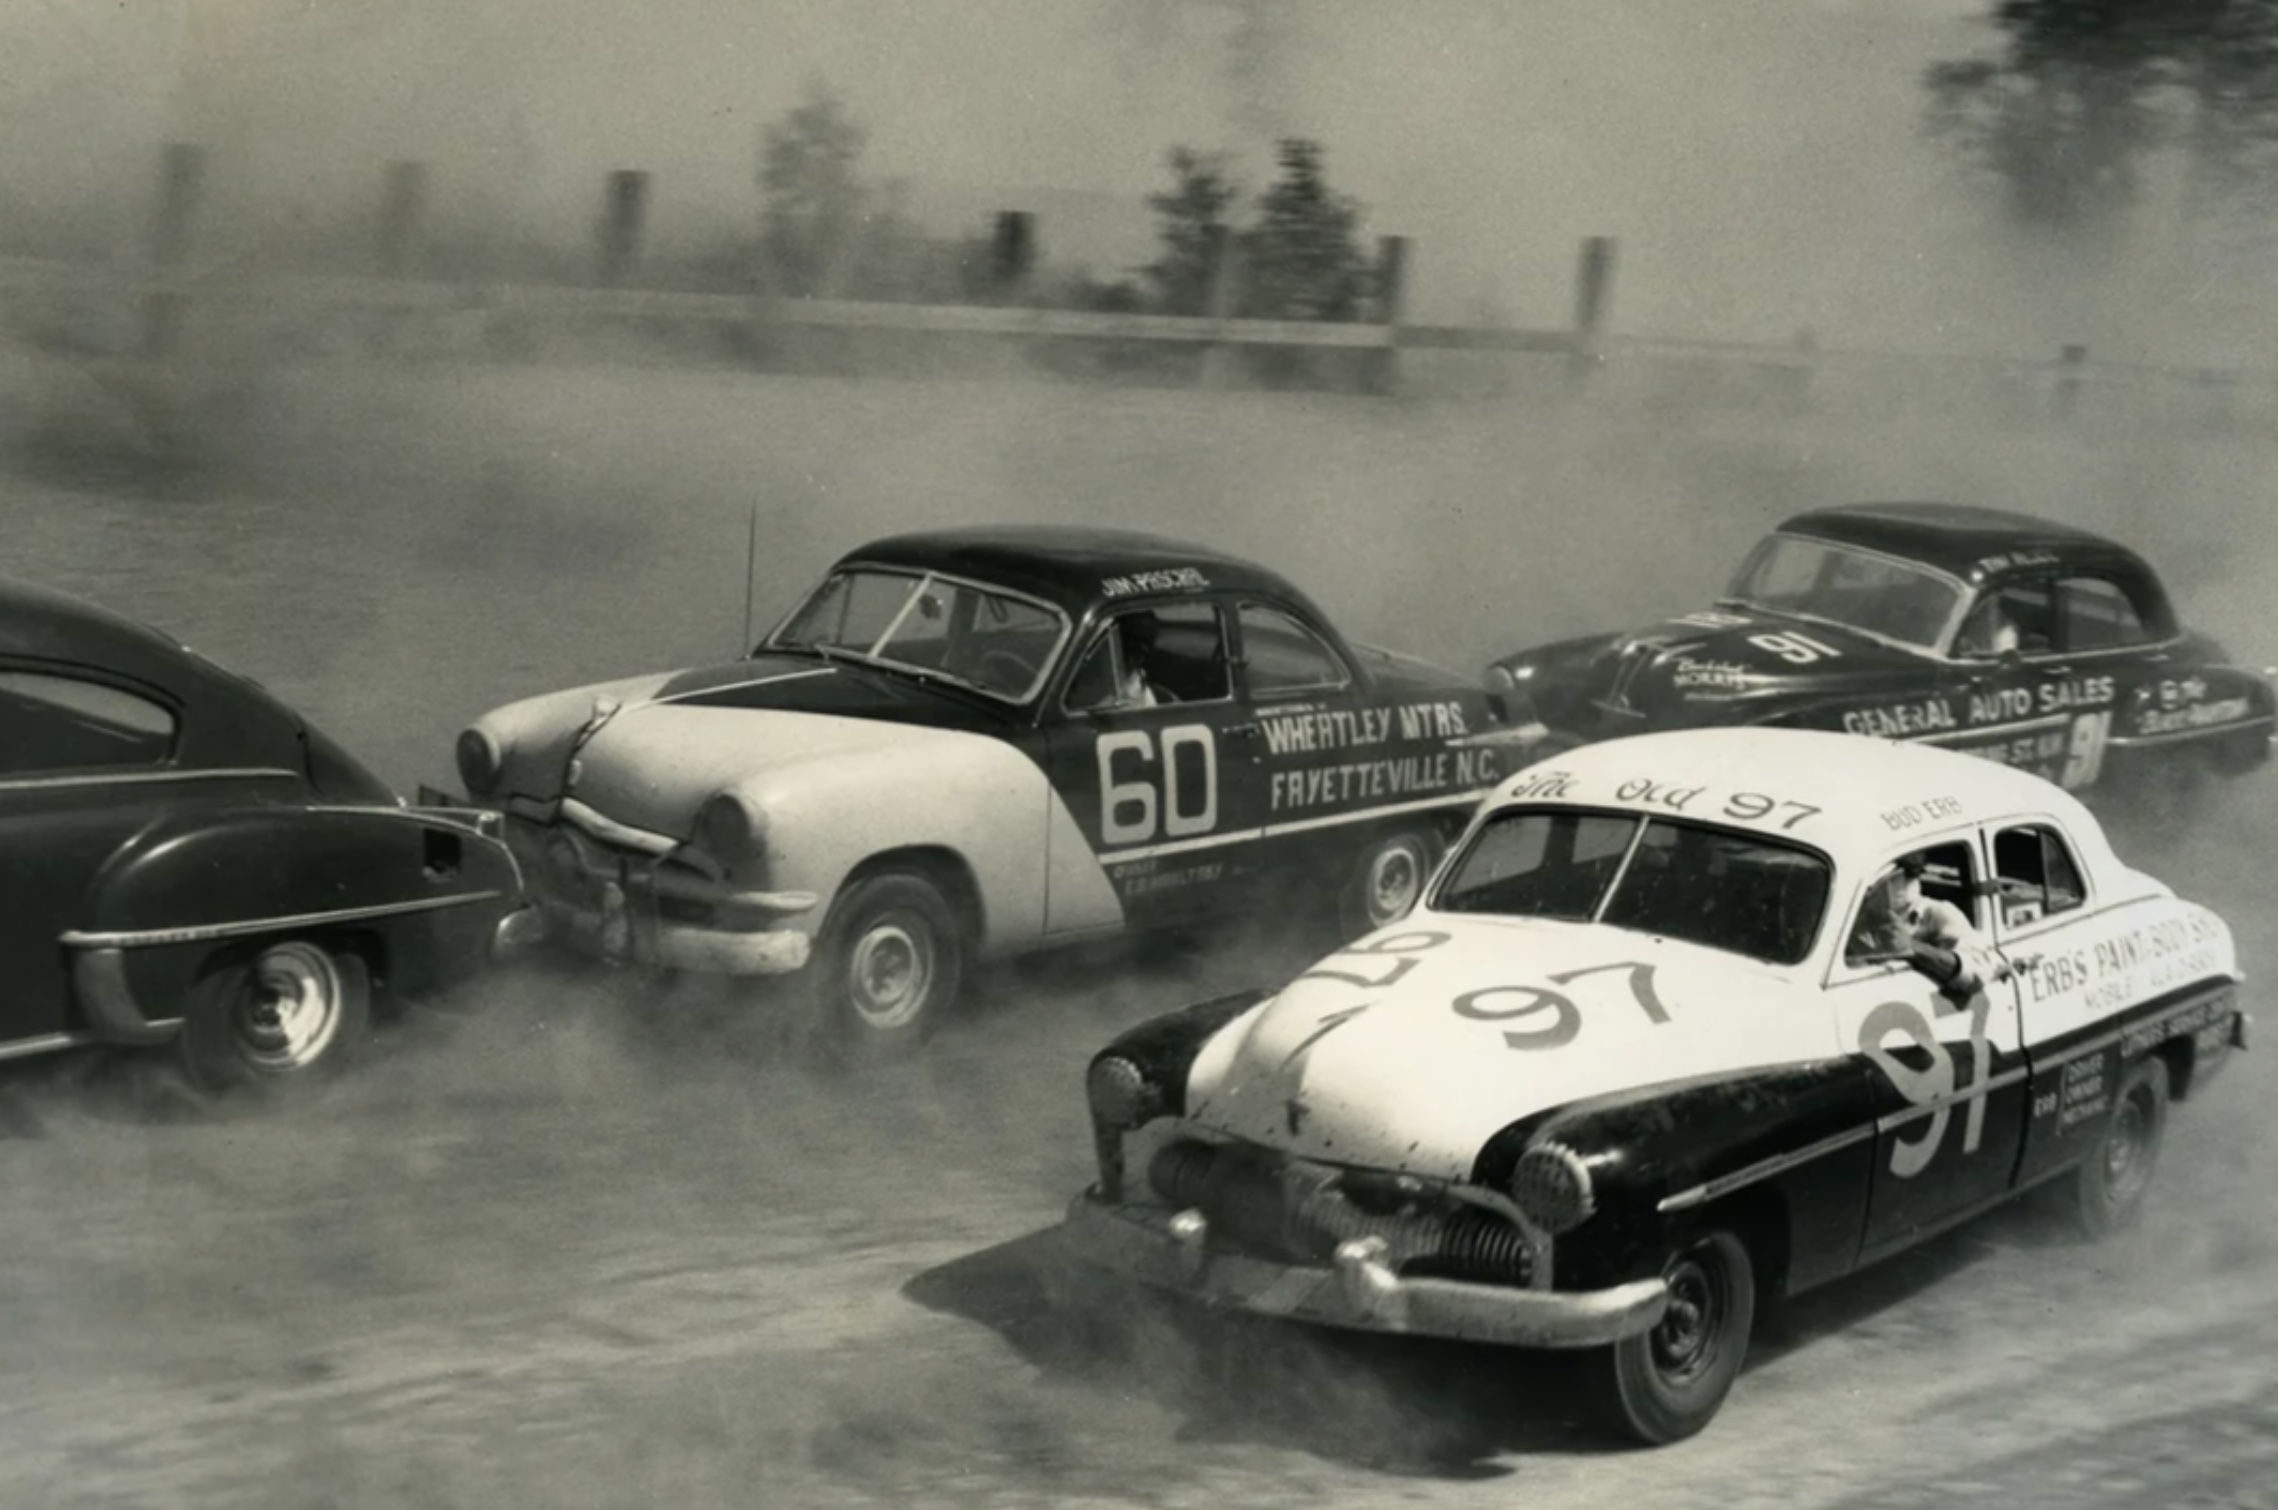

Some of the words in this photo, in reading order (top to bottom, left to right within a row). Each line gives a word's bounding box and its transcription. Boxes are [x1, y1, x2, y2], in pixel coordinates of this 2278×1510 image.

[1746, 631, 1842, 664] 91
[1261, 707, 1391, 754] WHEATLEY
[1843, 700, 1957, 738] GENERAL
[1969, 688, 2032, 723] AUTO
[2039, 676, 2116, 712] SALES
[1096, 723, 1217, 845] 60
[1271, 753, 1448, 811] FAYETTEVILLE
[1723, 792, 1822, 830] 97
[1880, 804, 1922, 831] BUD
[1922, 796, 1963, 819] ERB
[1451, 961, 1672, 1051] 97
[1857, 990, 1992, 1177] 97
